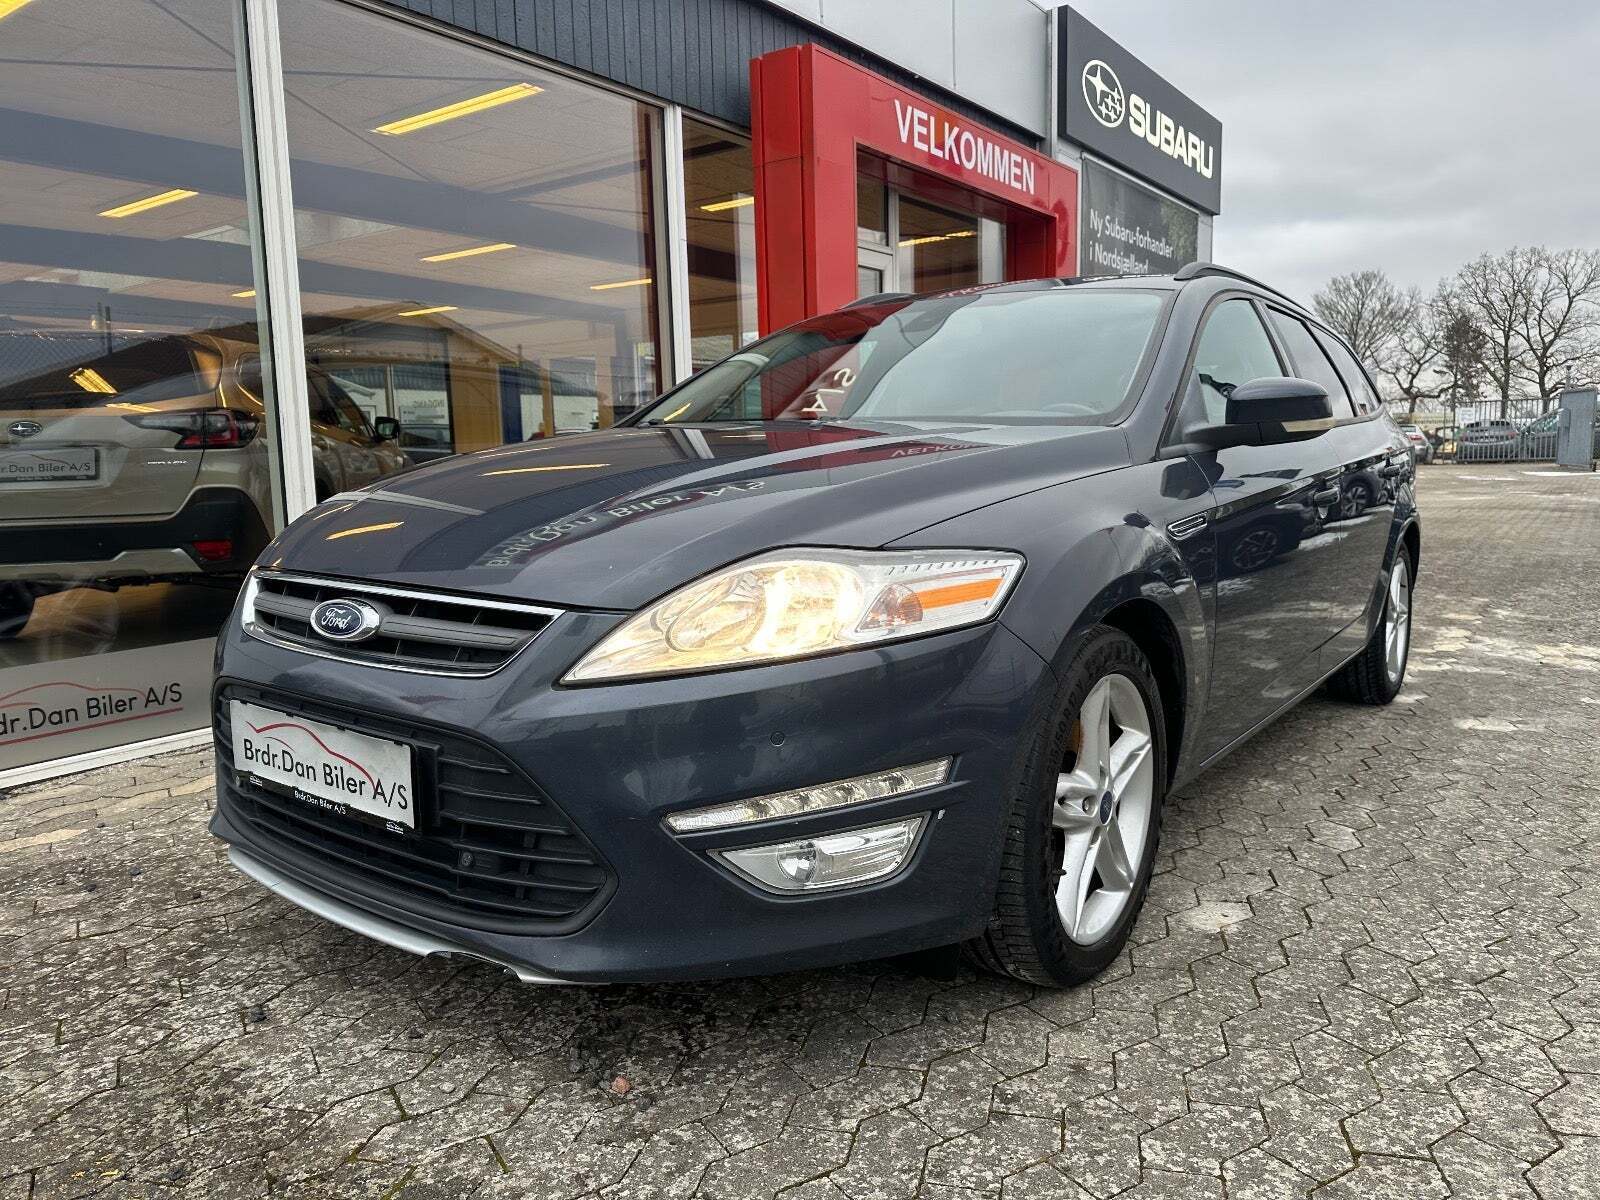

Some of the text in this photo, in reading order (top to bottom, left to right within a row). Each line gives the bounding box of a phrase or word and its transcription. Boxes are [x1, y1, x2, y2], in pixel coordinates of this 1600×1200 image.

[894, 99, 1035, 195] VELKOMMEN
[1129, 93, 1214, 179] SUBARU
[1089, 208, 1174, 257] Ny Subaru-forhandler
[1089, 245, 1149, 274] i Nordsjælland
[38, 463, 65, 472] Biler
[69, 462, 91, 472] A/S
[321, 607, 351, 630] Ford
[86, 694, 137, 719] Biler
[144, 682, 183, 708] A/S
[243, 738, 408, 810] Brdr.Dan Biler A/S
[320, 798, 333, 810] Biler
[334, 802, 347, 815] A/S
